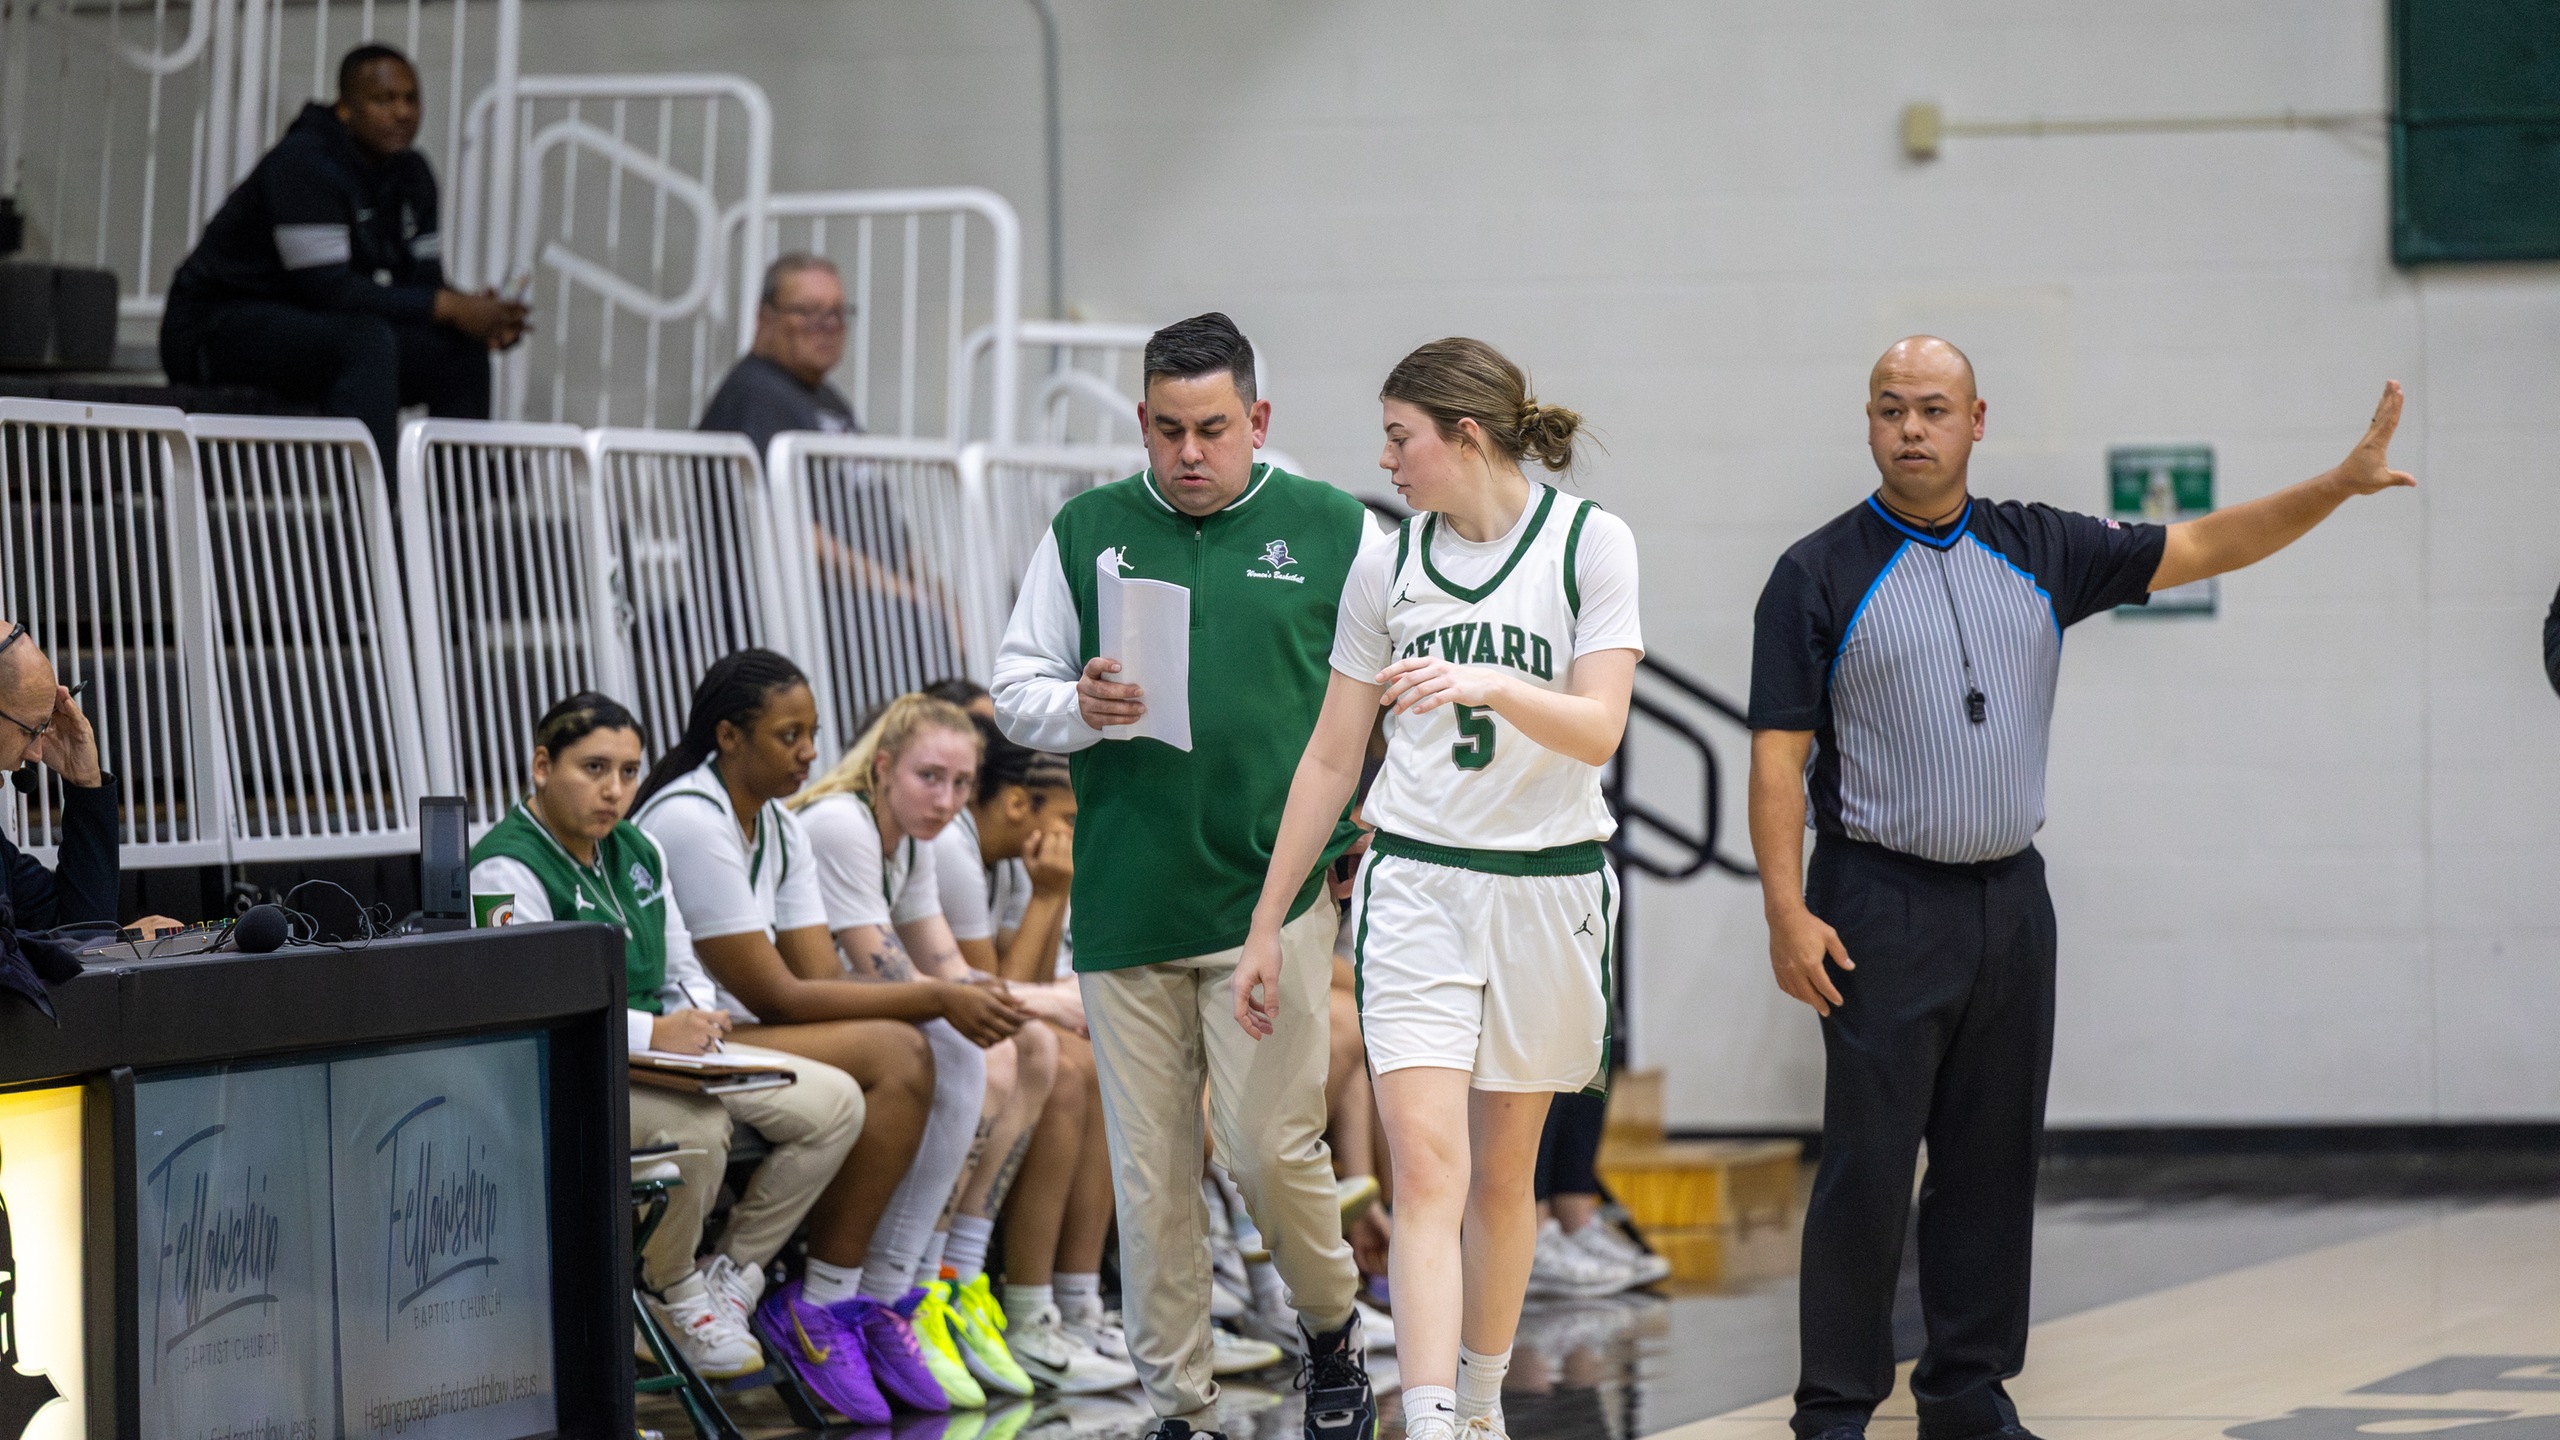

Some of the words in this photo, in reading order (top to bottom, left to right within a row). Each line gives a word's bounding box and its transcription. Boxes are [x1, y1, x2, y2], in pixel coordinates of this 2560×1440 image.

[1246, 569, 1272, 578] Women's
[1273, 571, 1305, 584] Basketball
[1452, 702, 1496, 771] 5
[376, 1096, 499, 1344] Fellowship
[148, 1124, 279, 1384] Fellowship
[413, 1299, 455, 1330] BAPTIST
[459, 1291, 502, 1321] CHURCH
[184, 1339, 229, 1371] BAPTIST
[234, 1332, 280, 1361] CHURCH
[365, 1396, 403, 1436] Helping
[404, 1386, 439, 1433] people
[440, 1382, 459, 1415] find
[461, 1375, 480, 1411] and
[481, 1373, 509, 1407] follow
[510, 1370, 537, 1401] Jesus
